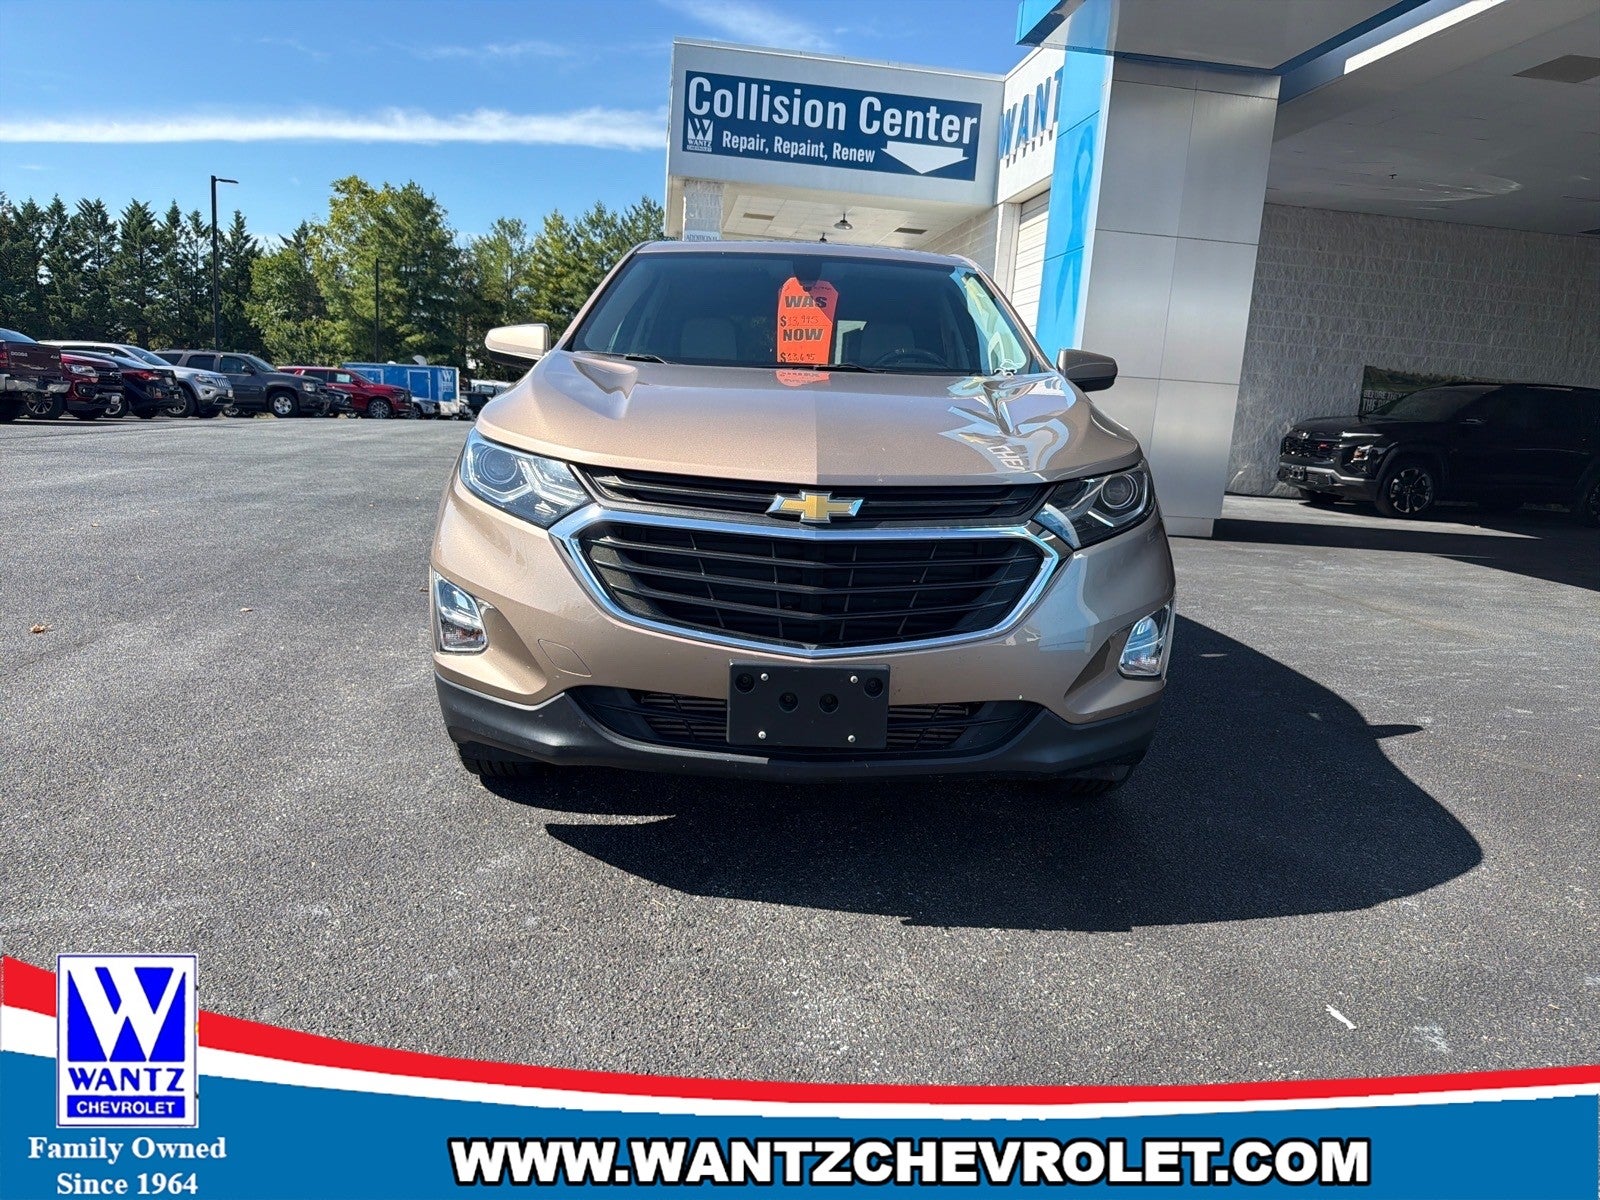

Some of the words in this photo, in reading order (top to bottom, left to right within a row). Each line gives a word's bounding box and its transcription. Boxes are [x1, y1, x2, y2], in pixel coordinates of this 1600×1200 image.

[688, 77, 847, 131] Collision
[859, 96, 978, 144] Center
[722, 130, 769, 154] Repair,
[773, 136, 828, 161] Repaint,
[832, 142, 876, 163] Renew
[784, 296, 828, 309] WAS
[782, 329, 824, 342] NOW
